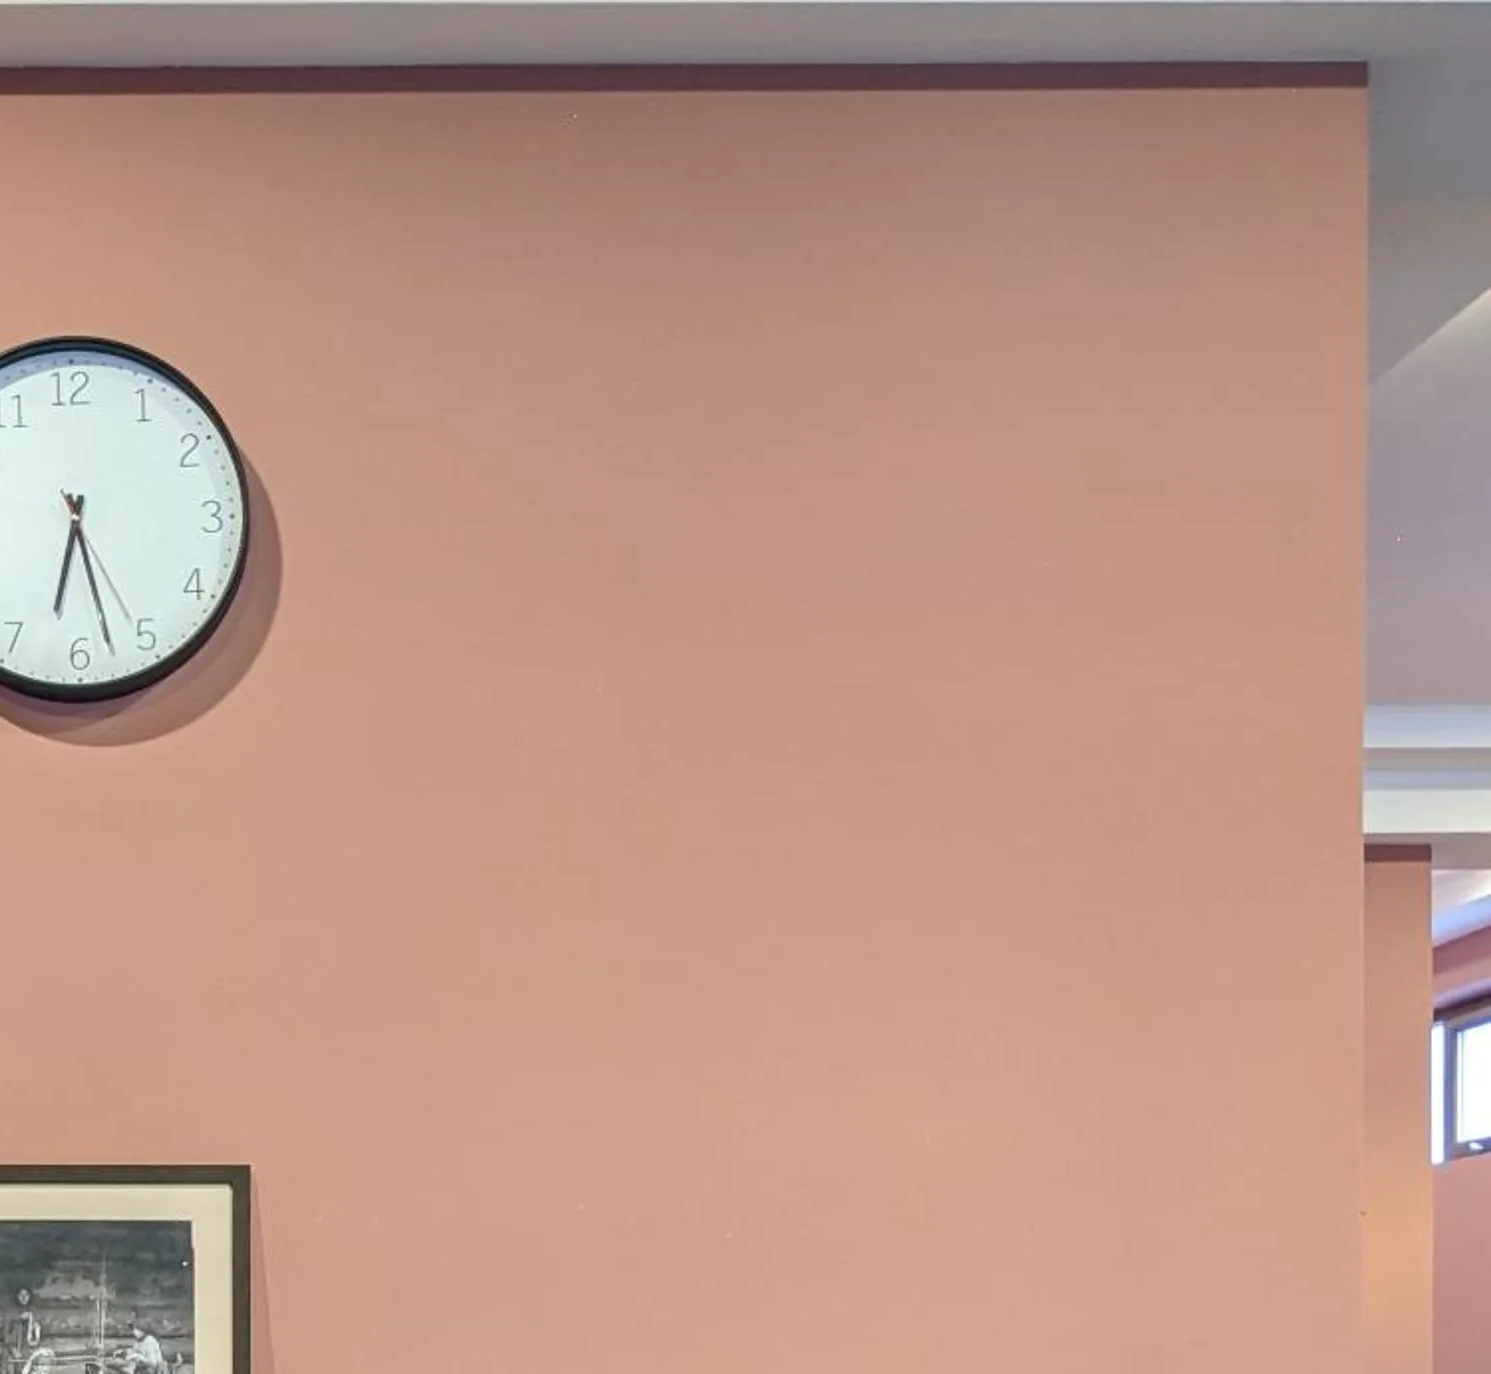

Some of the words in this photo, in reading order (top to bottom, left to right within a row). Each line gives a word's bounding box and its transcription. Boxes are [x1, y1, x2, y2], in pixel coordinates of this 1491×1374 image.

[50, 371, 91, 406] 12
[134, 388, 152, 423] 1
[179, 432, 200, 468] 2
[201, 499, 224, 535] 3
[183, 567, 206, 601] 4
[3, 621, 24, 654] 7
[136, 617, 157, 651] 5
[69, 637, 91, 671] 6
